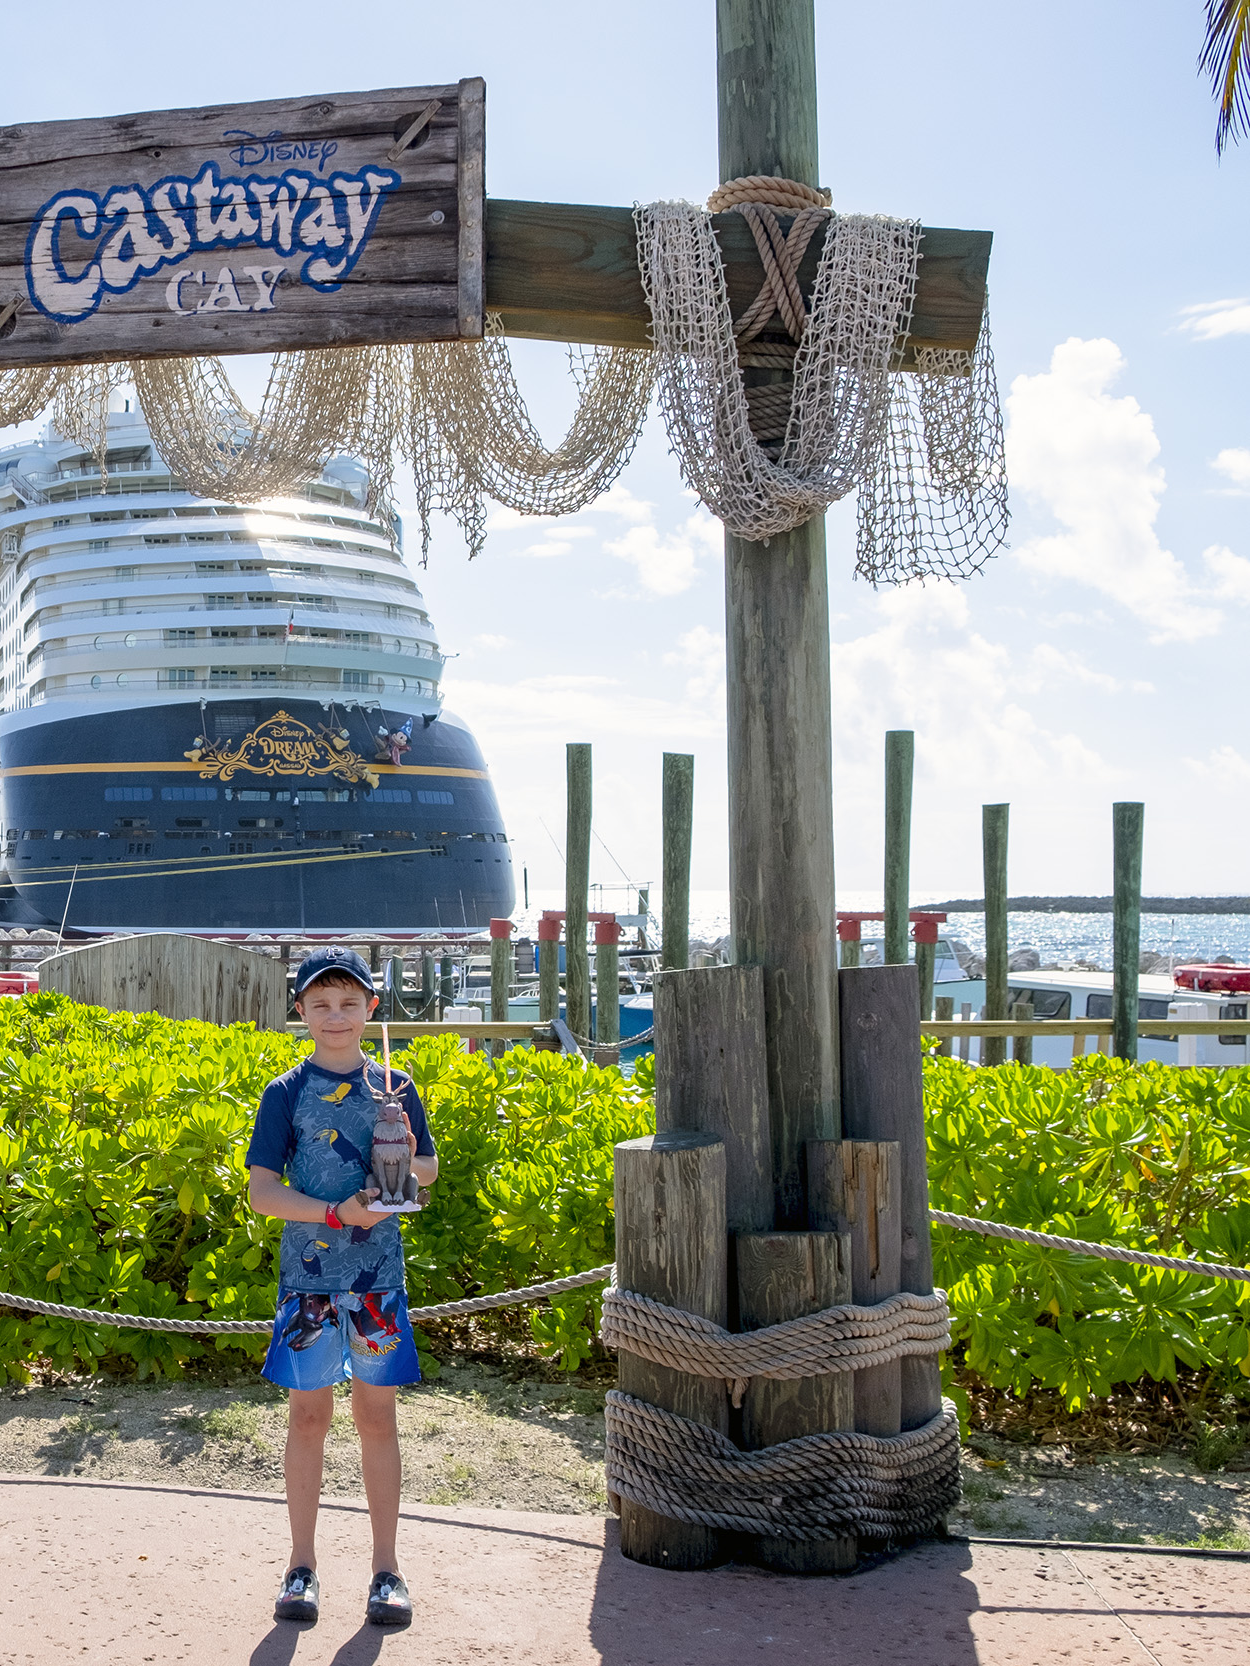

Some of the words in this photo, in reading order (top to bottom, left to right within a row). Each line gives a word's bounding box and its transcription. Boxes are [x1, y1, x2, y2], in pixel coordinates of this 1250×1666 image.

[25, 161, 402, 323] Castaway
[165, 270, 287, 316] CAY
[258, 737, 320, 761] DREAM
